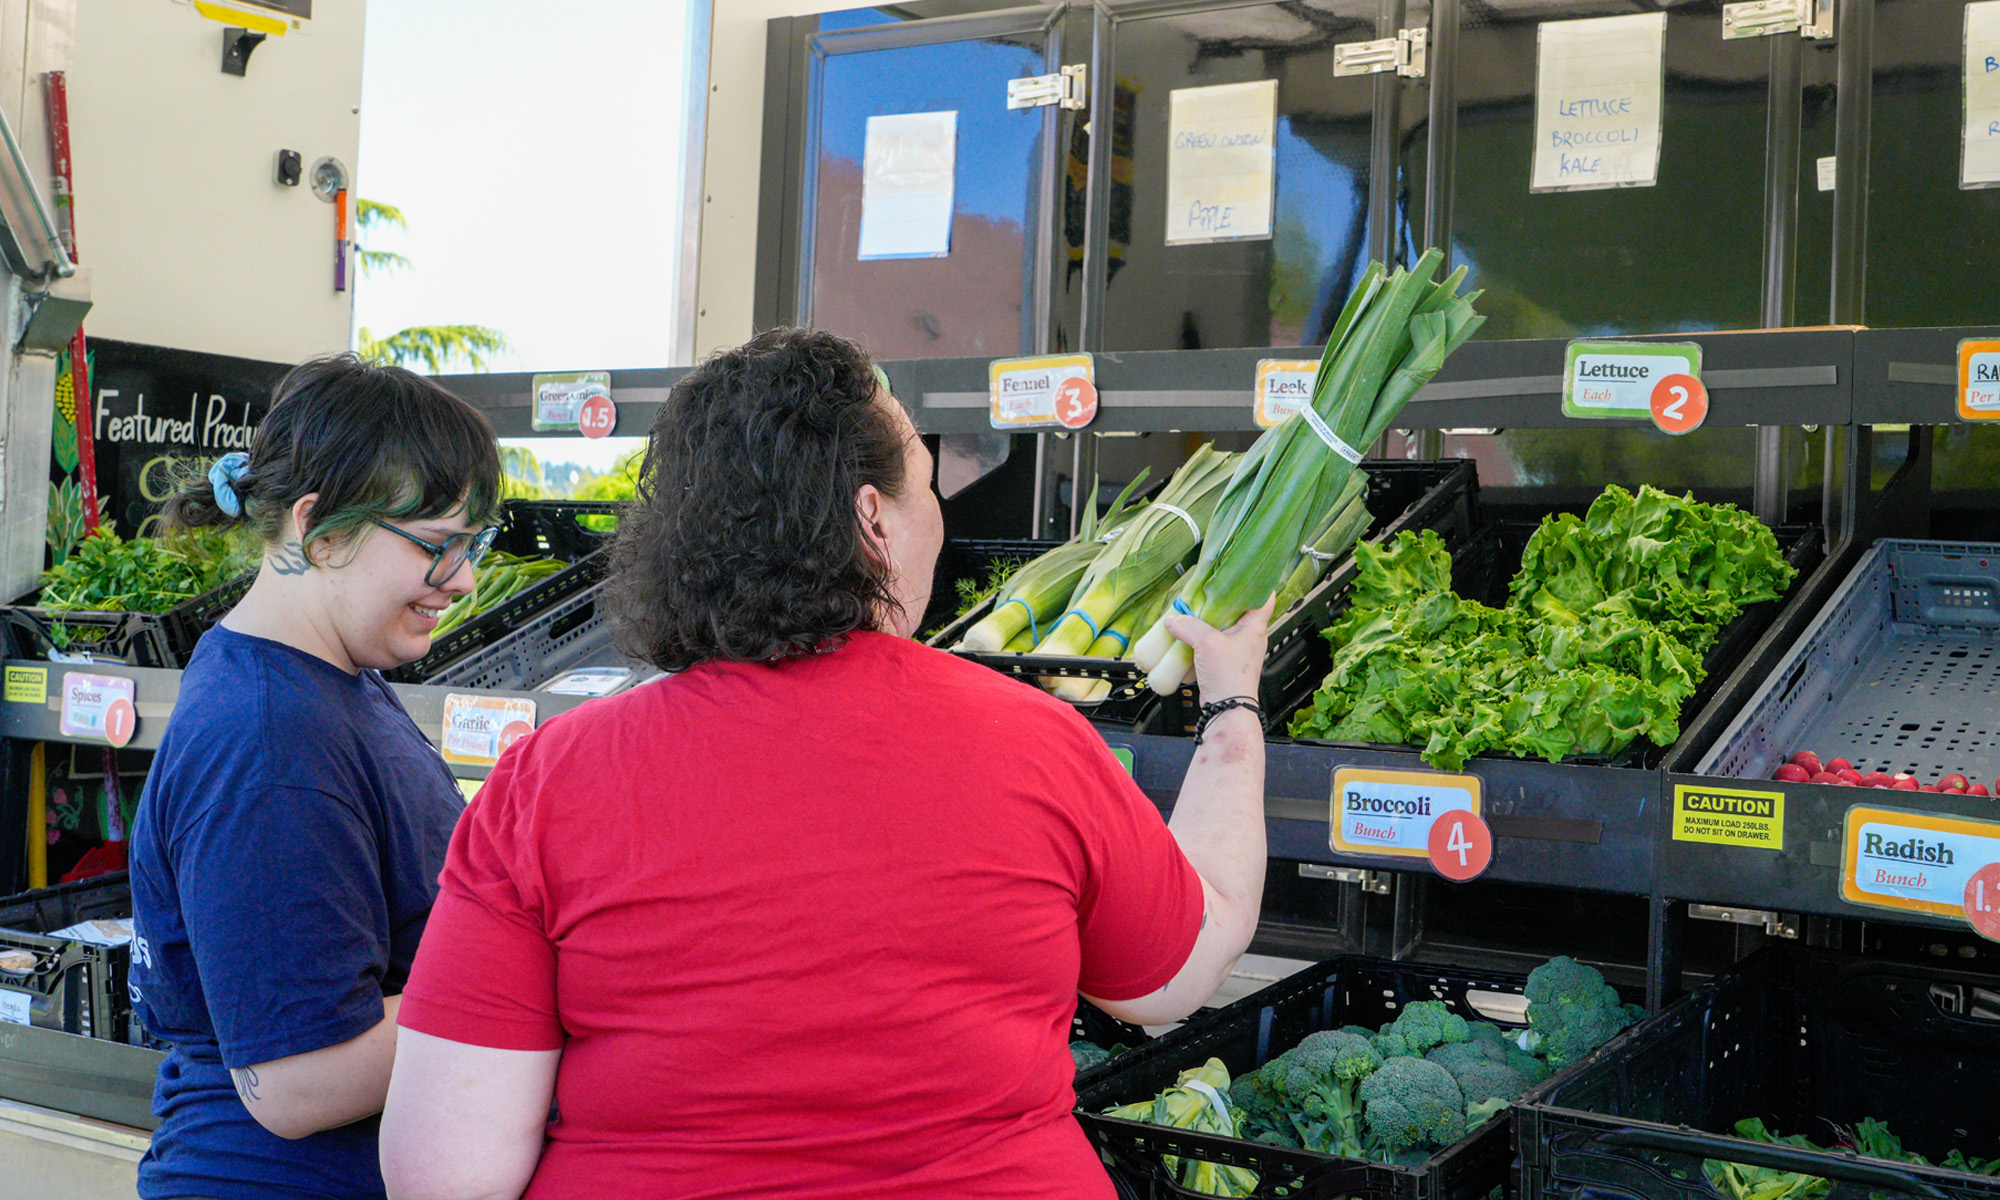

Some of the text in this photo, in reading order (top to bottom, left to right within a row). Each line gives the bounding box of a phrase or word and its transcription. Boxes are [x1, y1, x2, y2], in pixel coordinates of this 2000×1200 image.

[1560, 96, 1632, 117] LETTUCE
[1175, 131, 1216, 149] GREEN
[1552, 127, 1639, 148] BROCCOLI
[1560, 153, 1602, 177] KALE
[1188, 200, 1235, 232] APPLE
[1579, 360, 1649, 378] Lettuce
[1977, 363, 2000, 380] RA
[1003, 375, 1050, 392] Fennel
[1269, 379, 1307, 394] Leek
[540, 390, 569, 401] Green
[1064, 387, 1083, 418] 3
[1583, 388, 1612, 401] Each
[1662, 385, 1689, 421] 2
[1970, 390, 1994, 404] Per
[1009, 398, 1032, 411] Each
[1273, 403, 1294, 416] Bun
[95, 389, 258, 448] Featured Produ
[585, 406, 609, 429] 1.5
[10, 672, 42, 683] CAUTION
[71, 687, 102, 703] Spices
[115, 709, 124, 736] 1
[452, 714, 490, 730] Garlic
[447, 734, 488, 751] Per Pound
[1346, 791, 1431, 816] Broccoli
[1687, 795, 1770, 815] CAUTION
[1354, 822, 1396, 840] Bunch
[1683, 825, 1771, 840] DO NOT SIT ON DRAWER.
[1685, 817, 1770, 831] MAXIMUM LOAD 250LBS.
[1447, 821, 1473, 866] 4
[1864, 832, 1955, 865] Radish
[1874, 868, 1927, 888] Bunch
[1975, 879, 2000, 914] 1.
